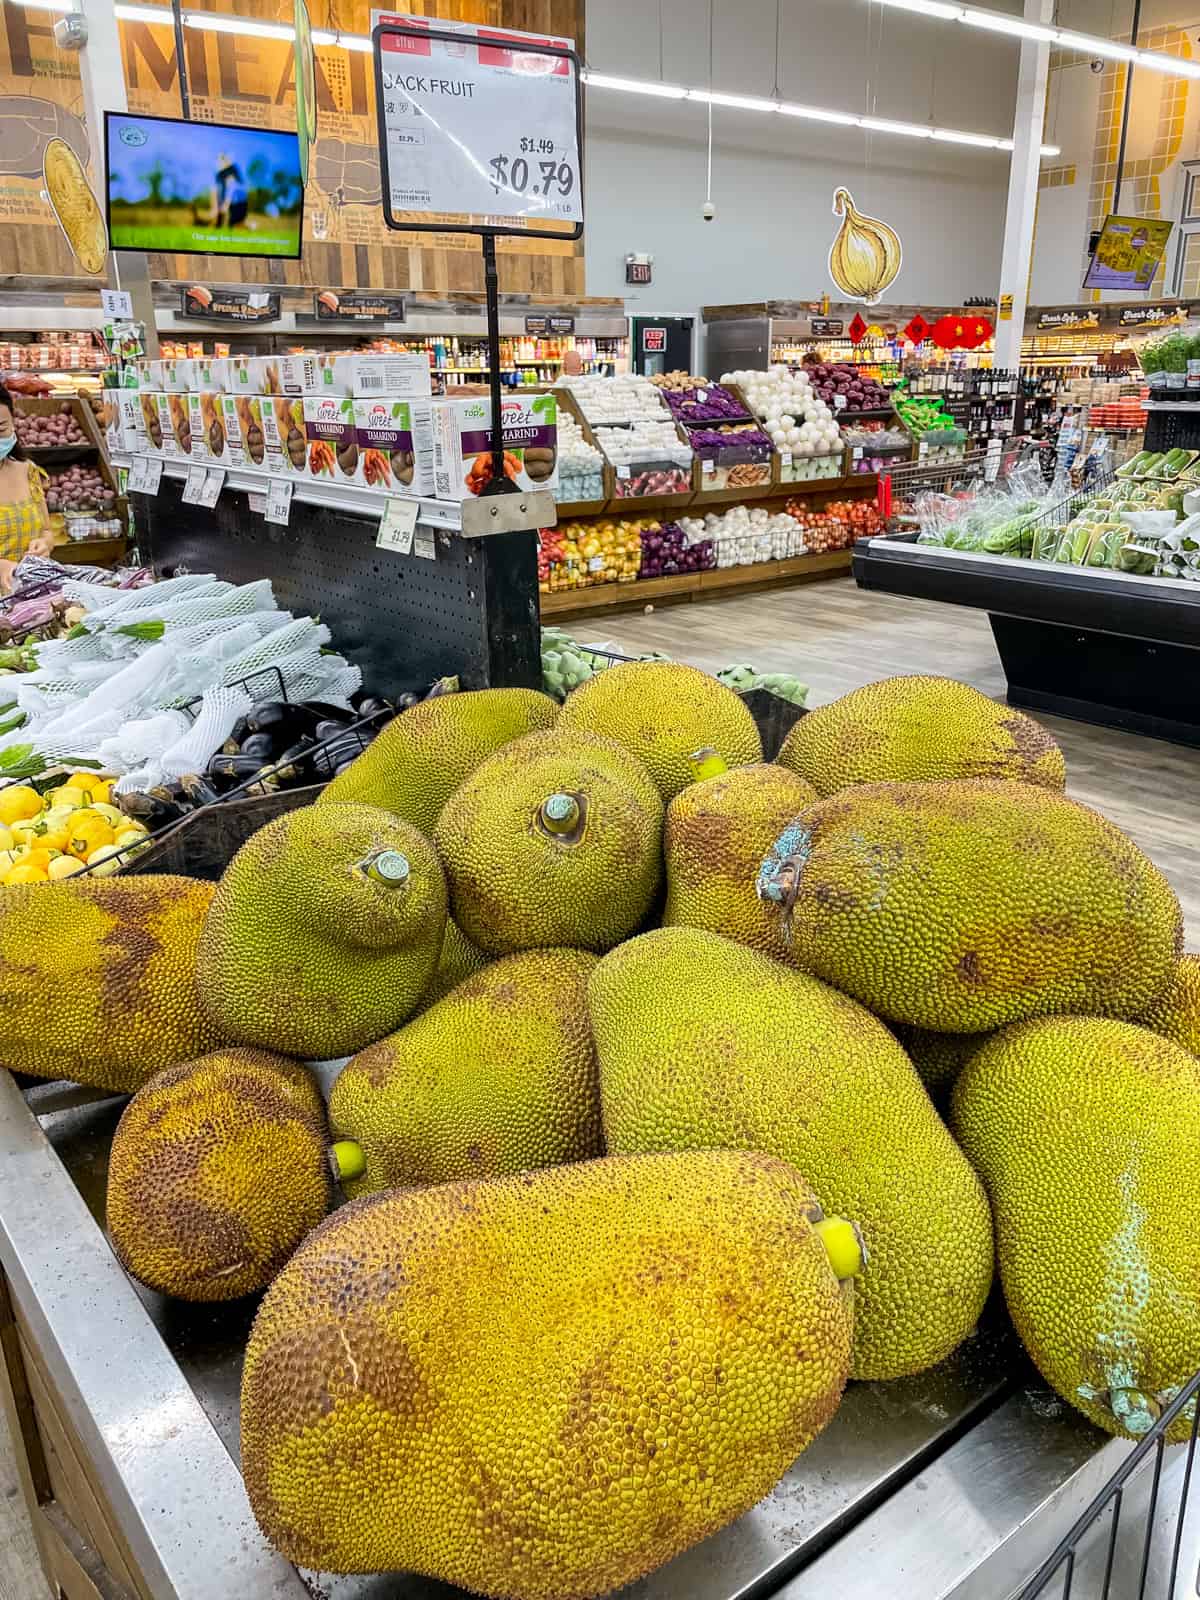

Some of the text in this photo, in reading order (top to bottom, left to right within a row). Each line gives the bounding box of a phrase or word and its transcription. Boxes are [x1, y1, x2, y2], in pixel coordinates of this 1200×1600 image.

[383, 74, 475, 98] JACK FRUIT
[519, 137, 554, 154] $1.49
[489, 153, 574, 197] $0.79
[633, 264, 649, 281] EXIT
[645, 330, 664, 340] KEEP
[647, 339, 662, 349] OUT
[314, 423, 345, 434] TAMARIND
[485, 428, 539, 442] TMARIND
[367, 430, 398, 442] TAMARIND
